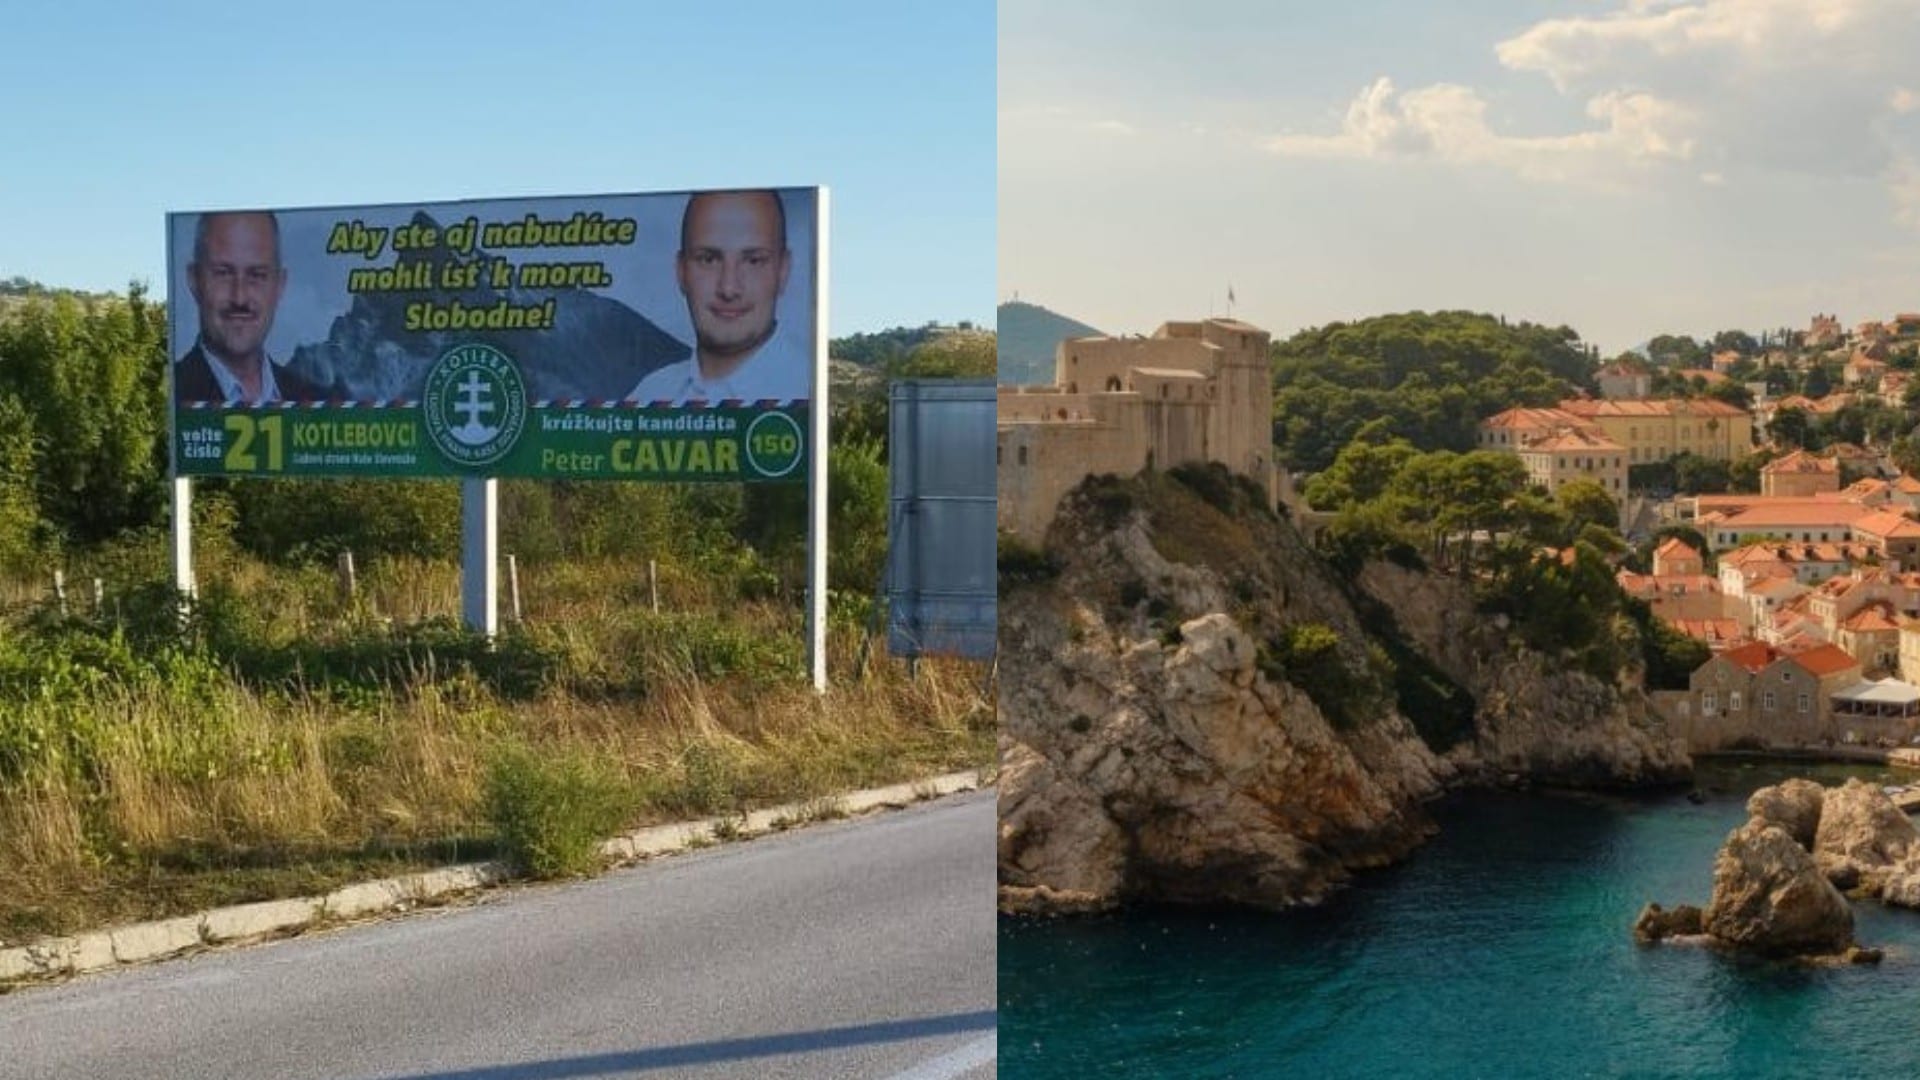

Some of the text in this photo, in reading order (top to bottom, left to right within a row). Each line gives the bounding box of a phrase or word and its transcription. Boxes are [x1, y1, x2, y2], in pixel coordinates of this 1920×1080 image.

[328, 212, 636, 259] Aby ste aj nabudúce
[349, 260, 432, 292] mohli
[489, 257, 515, 289] k
[520, 261, 612, 289] moru.
[405, 300, 555, 331] Slobodne!
[292, 422, 417, 447] KOTLEBOVCI
[542, 414, 737, 433] krúžkujte kandidáta
[225, 415, 282, 471] 21
[541, 439, 739, 472] Peter CAVAR
[753, 435, 797, 454] 150
